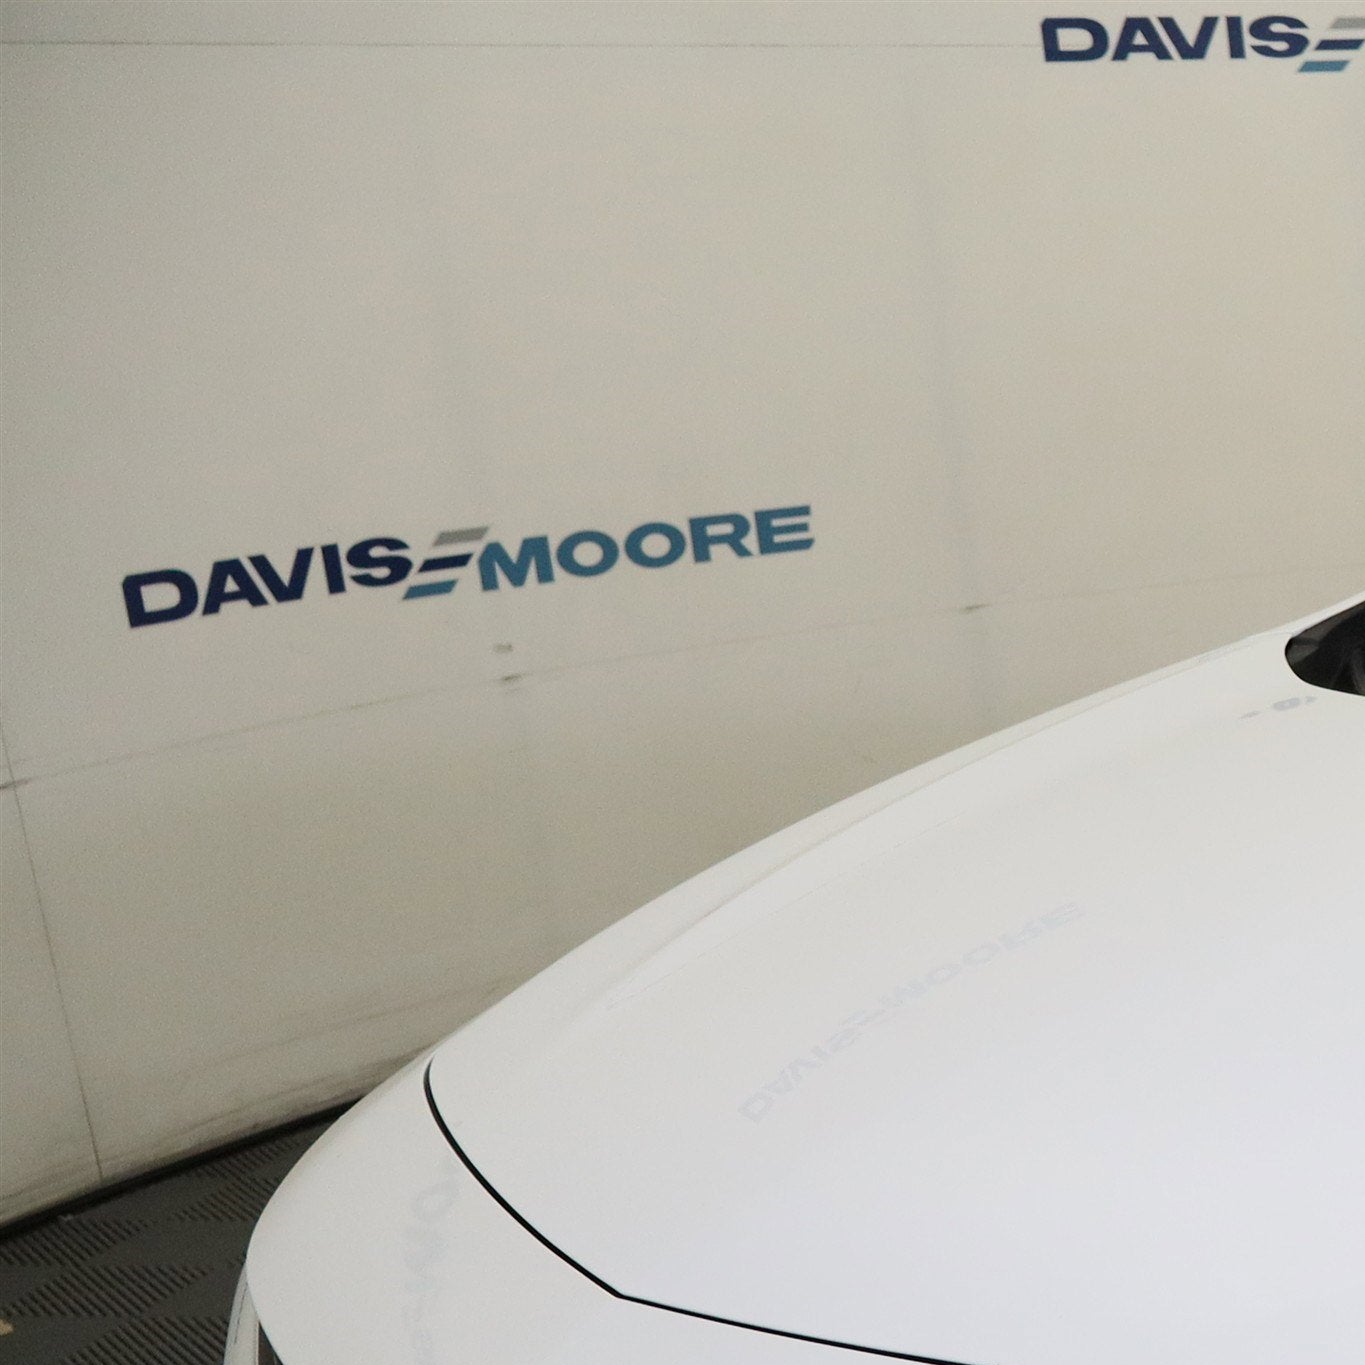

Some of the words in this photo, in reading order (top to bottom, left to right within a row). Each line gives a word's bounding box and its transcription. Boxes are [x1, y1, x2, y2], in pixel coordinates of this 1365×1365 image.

[1040, 15, 1310, 63] DAVIS
[121, 536, 414, 630] DAVIS
[477, 504, 816, 593] MOORE
